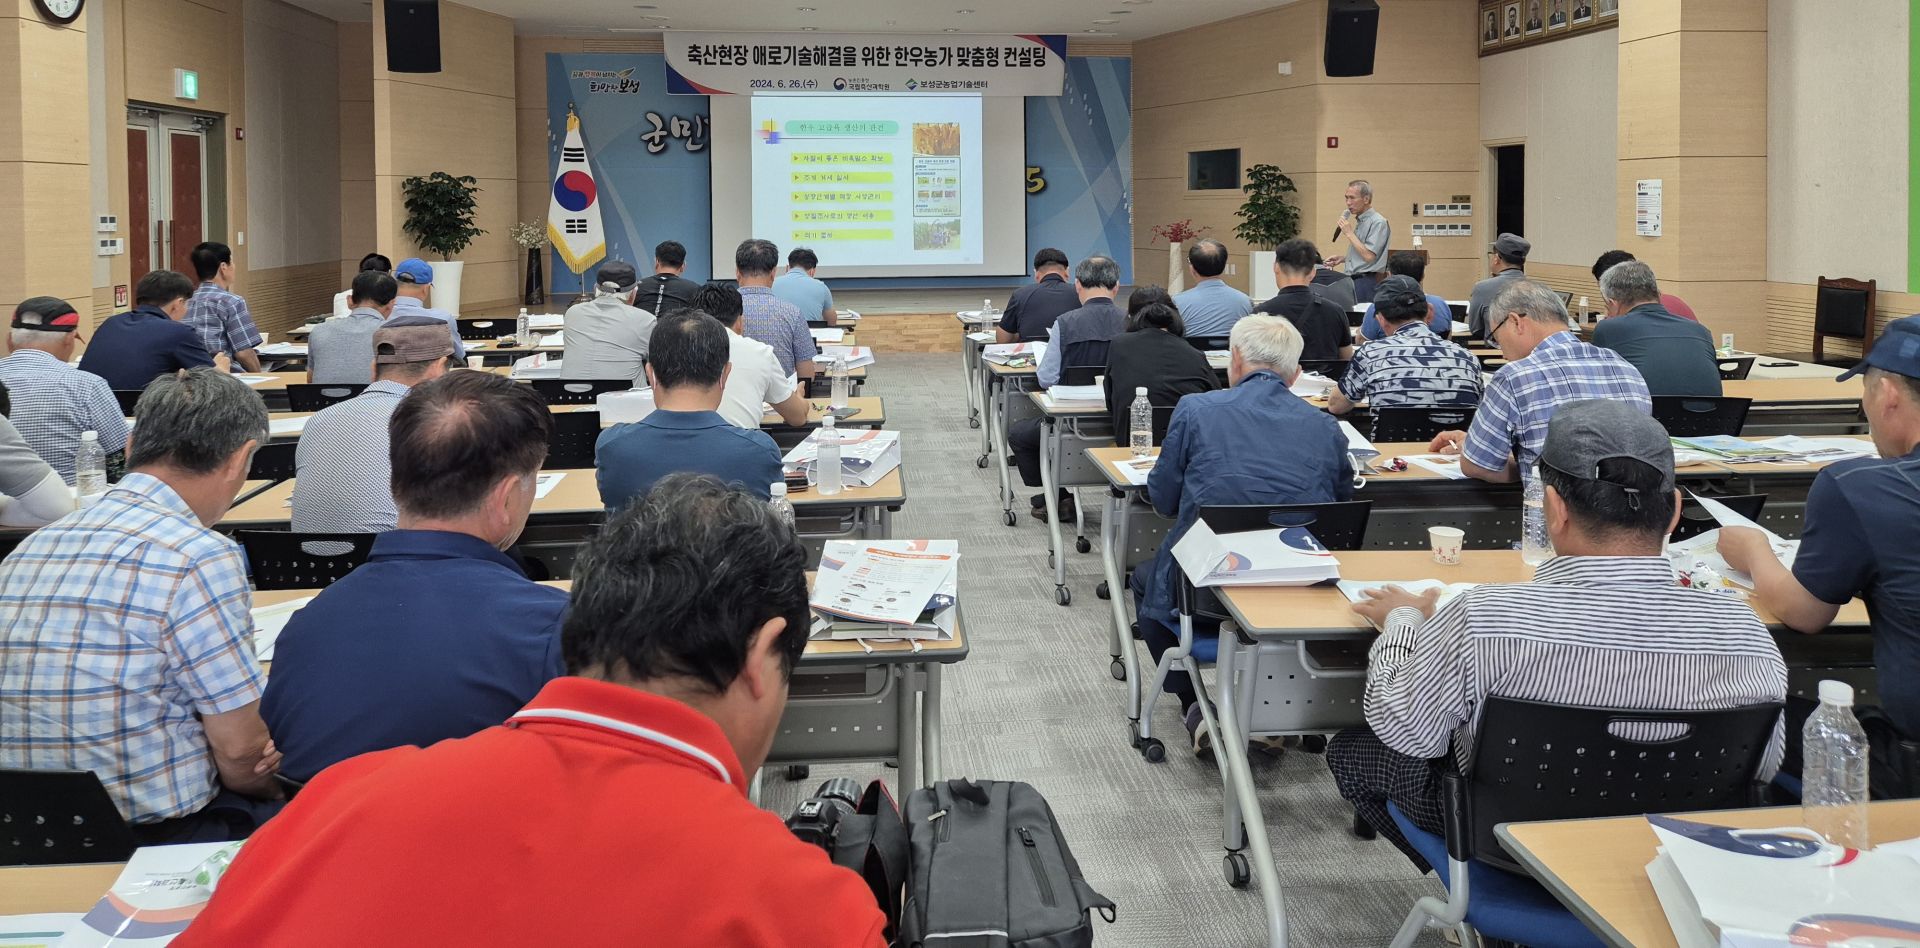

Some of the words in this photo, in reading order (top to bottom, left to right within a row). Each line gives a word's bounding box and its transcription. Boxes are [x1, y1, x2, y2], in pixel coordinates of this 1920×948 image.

[688, 44, 748, 66] 축산현장
[753, 45, 857, 67] 애로기술해결을
[861, 46, 890, 67] 위한
[895, 46, 953, 67] 한우농가
[957, 46, 999, 67] 맞춤형
[1004, 46, 1046, 68] 컨설팅
[618, 78, 640, 93] 보성
[750, 79, 775, 88] 2024.
[778, 79, 787, 88] 6.
[848, 83, 890, 91] 국립축산과학원
[920, 80, 988, 89] 보성군농업기술센터
